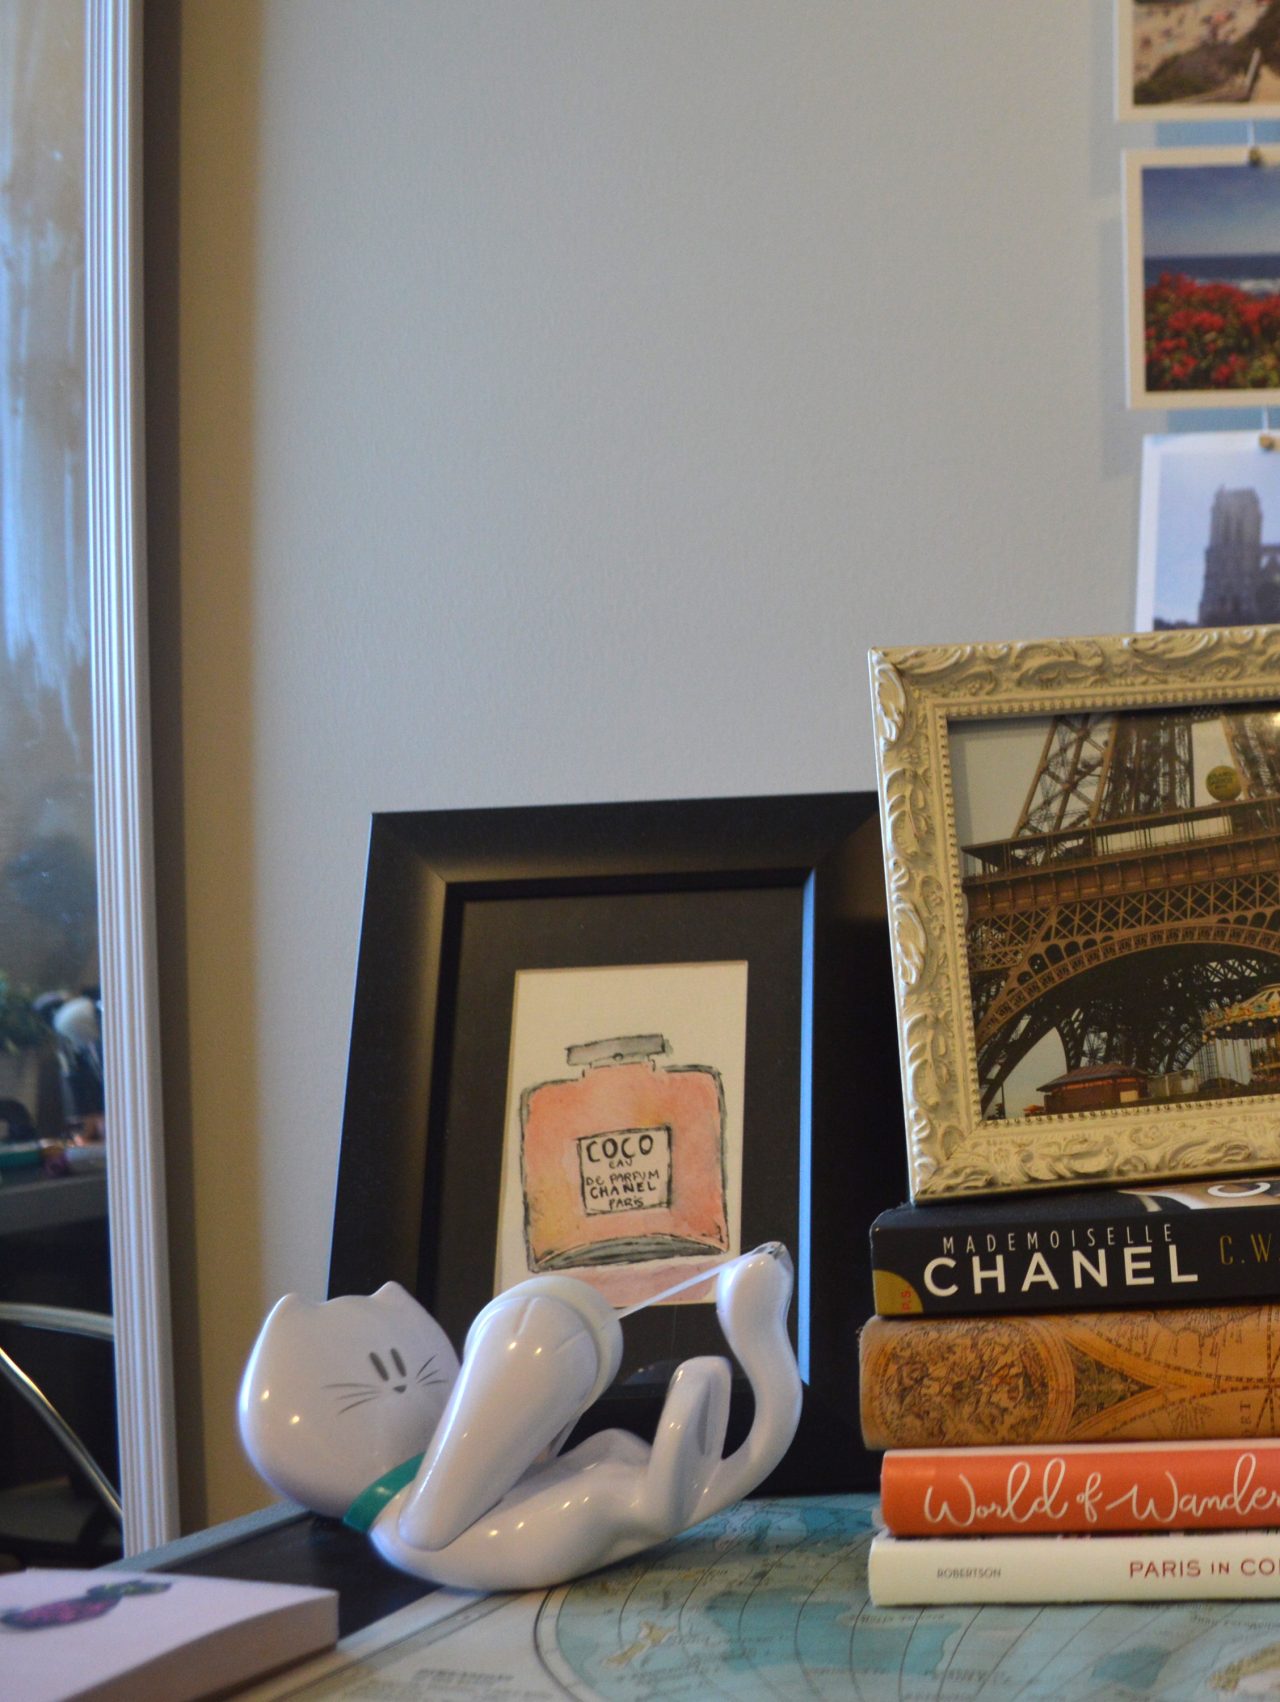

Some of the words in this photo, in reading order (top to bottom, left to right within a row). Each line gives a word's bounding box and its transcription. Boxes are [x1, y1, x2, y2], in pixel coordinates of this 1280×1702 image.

[586, 1134, 654, 1163] COCO
[609, 1169, 660, 1185] PARFUM
[590, 1181, 657, 1200] CHANEL
[609, 1196, 645, 1210] PARIS
[942, 1223, 1173, 1255] MADEMOISELLE
[923, 1244, 1199, 1298] CHANEL
[923, 1457, 1069, 1528] World
[1076, 1471, 1103, 1523] of
[936, 1567, 1002, 1580] ROBERTSON
[1129, 1559, 1201, 1579] PARIS
